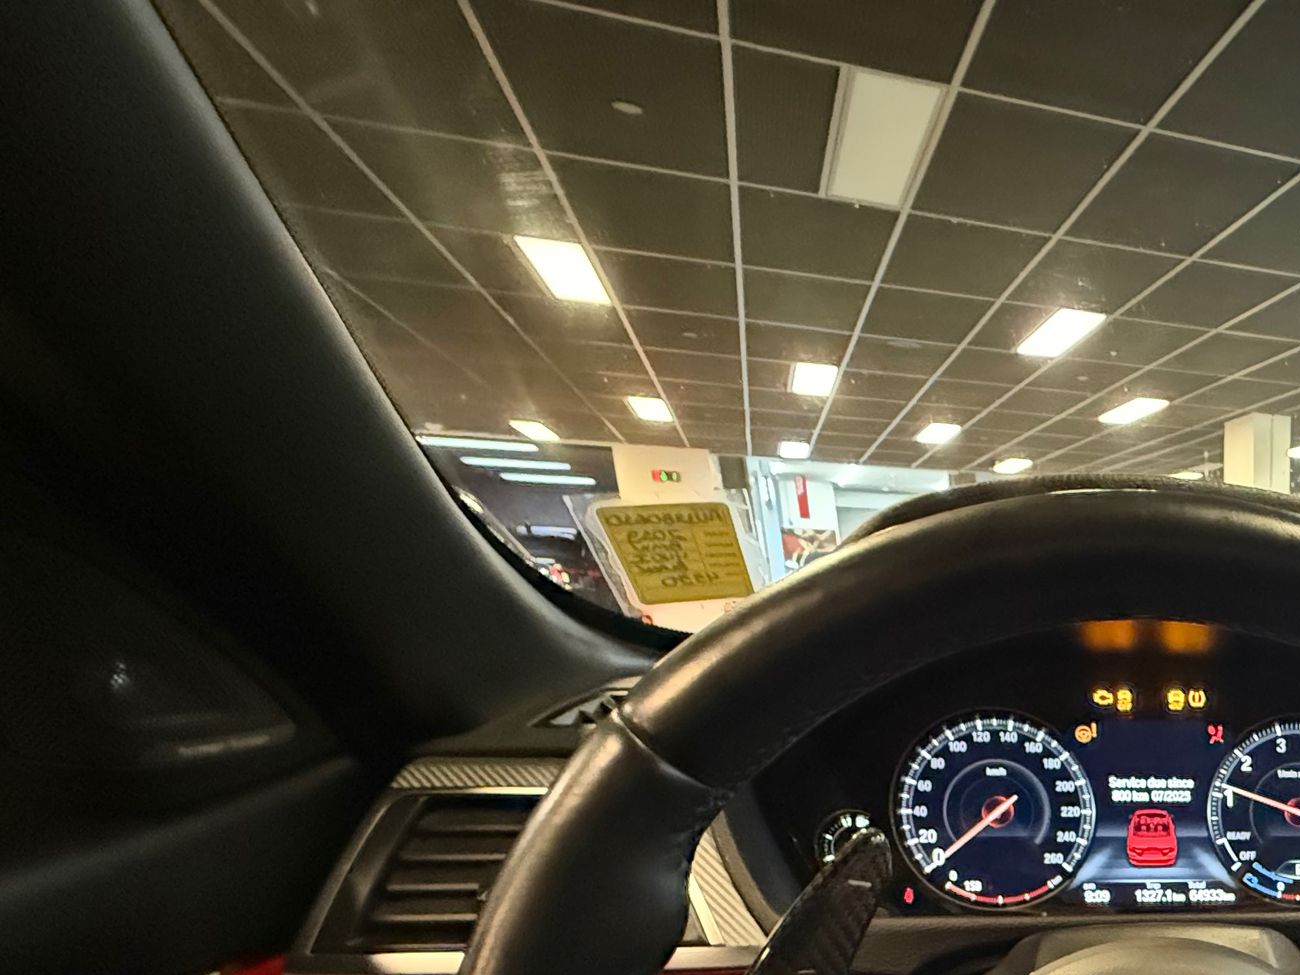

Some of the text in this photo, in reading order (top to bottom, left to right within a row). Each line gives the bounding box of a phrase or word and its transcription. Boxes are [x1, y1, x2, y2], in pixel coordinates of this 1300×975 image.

[972, 732, 990, 742] 120
[999, 732, 1017, 743] 140
[948, 742, 967, 752] 100
[1024, 742, 1043, 753] 160
[1276, 739, 1287, 753] 3
[930, 758, 945, 769] 80
[1043, 758, 1061, 769] 180
[1240, 755, 1252, 772] 2
[917, 780, 932, 792] 60
[1055, 781, 1075, 792] 200
[1108, 775, 1195, 789] Service due since
[1132, 790, 1150, 802] km
[913, 806, 928, 817] 40
[1060, 806, 1080, 817] 220
[918, 829, 937, 843] 20
[1056, 831, 1076, 843] 240
[1226, 831, 1251, 840] READY
[932, 848, 945, 866] 0
[1043, 853, 1063, 864] 260
[1239, 851, 1256, 861] OFF
